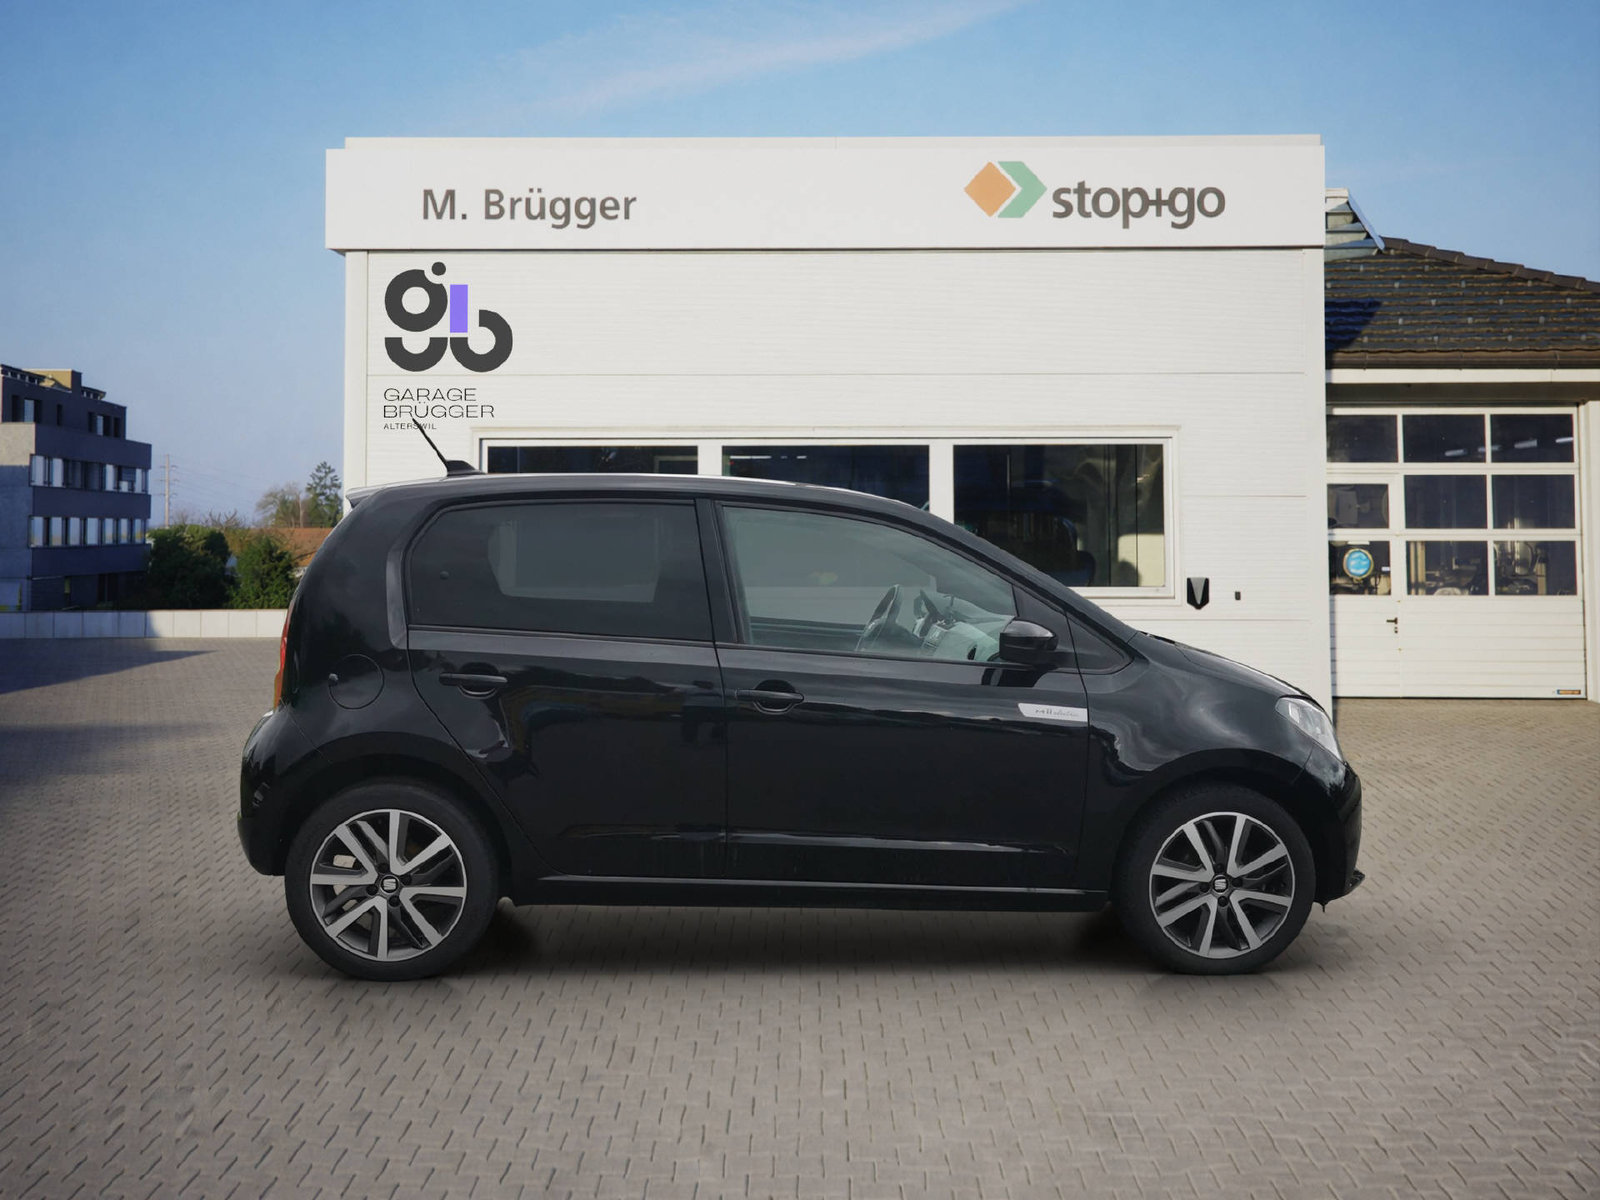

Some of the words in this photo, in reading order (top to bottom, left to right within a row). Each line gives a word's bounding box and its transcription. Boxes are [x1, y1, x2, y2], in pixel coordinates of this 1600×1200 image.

[423, 189, 468, 220] M.
[485, 188, 638, 229] Brügger
[1052, 180, 1226, 230] stop+go
[384, 388, 477, 401] GARAGE
[384, 401, 495, 418] BRÜGGER
